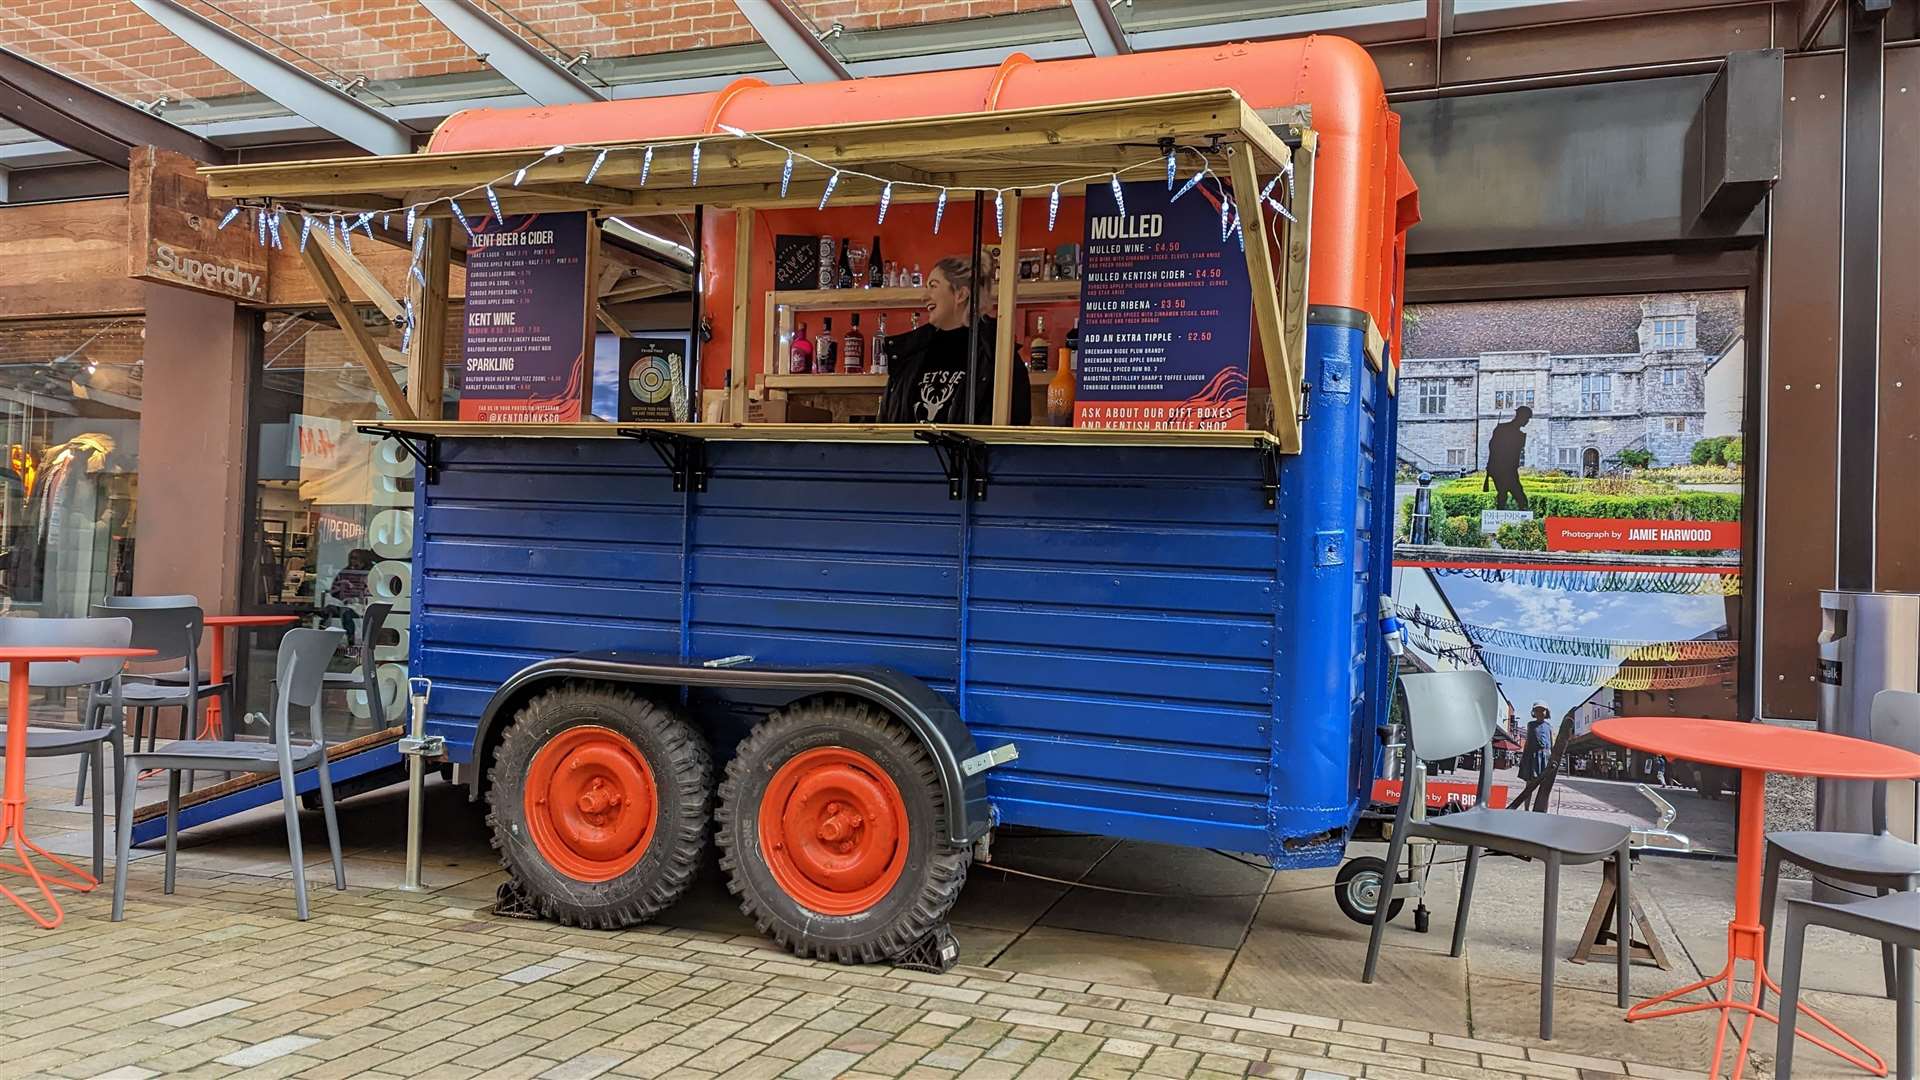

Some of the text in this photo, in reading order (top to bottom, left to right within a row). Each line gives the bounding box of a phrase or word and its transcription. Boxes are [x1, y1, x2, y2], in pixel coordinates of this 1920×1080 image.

[1091, 214, 1162, 240] MULLED
[472, 231, 553, 247] KENT BEER & CIDER
[1090, 242, 1180, 254] MULLED WINE £4.50
[1088, 269, 1221, 282] MULLED KENTISH CIDER £4.50
[1086, 300, 1186, 310] MULLED RIBENA £3.50
[469, 312, 515, 326] KENT WINE
[1085, 332, 1212, 342] ADD AN EXTRA TIPPLE £2.50
[467, 358, 514, 371] SPARKLING
[919, 371, 949, 384] ET'S
[1082, 408, 1232, 418] ASK ABOUT OUR GIFT BOXES
[1081, 421, 1227, 430] AND KENTISH BOTTLE SHOP
[1562, 529, 1711, 542] Photograph by JAMIE HARWOOD
